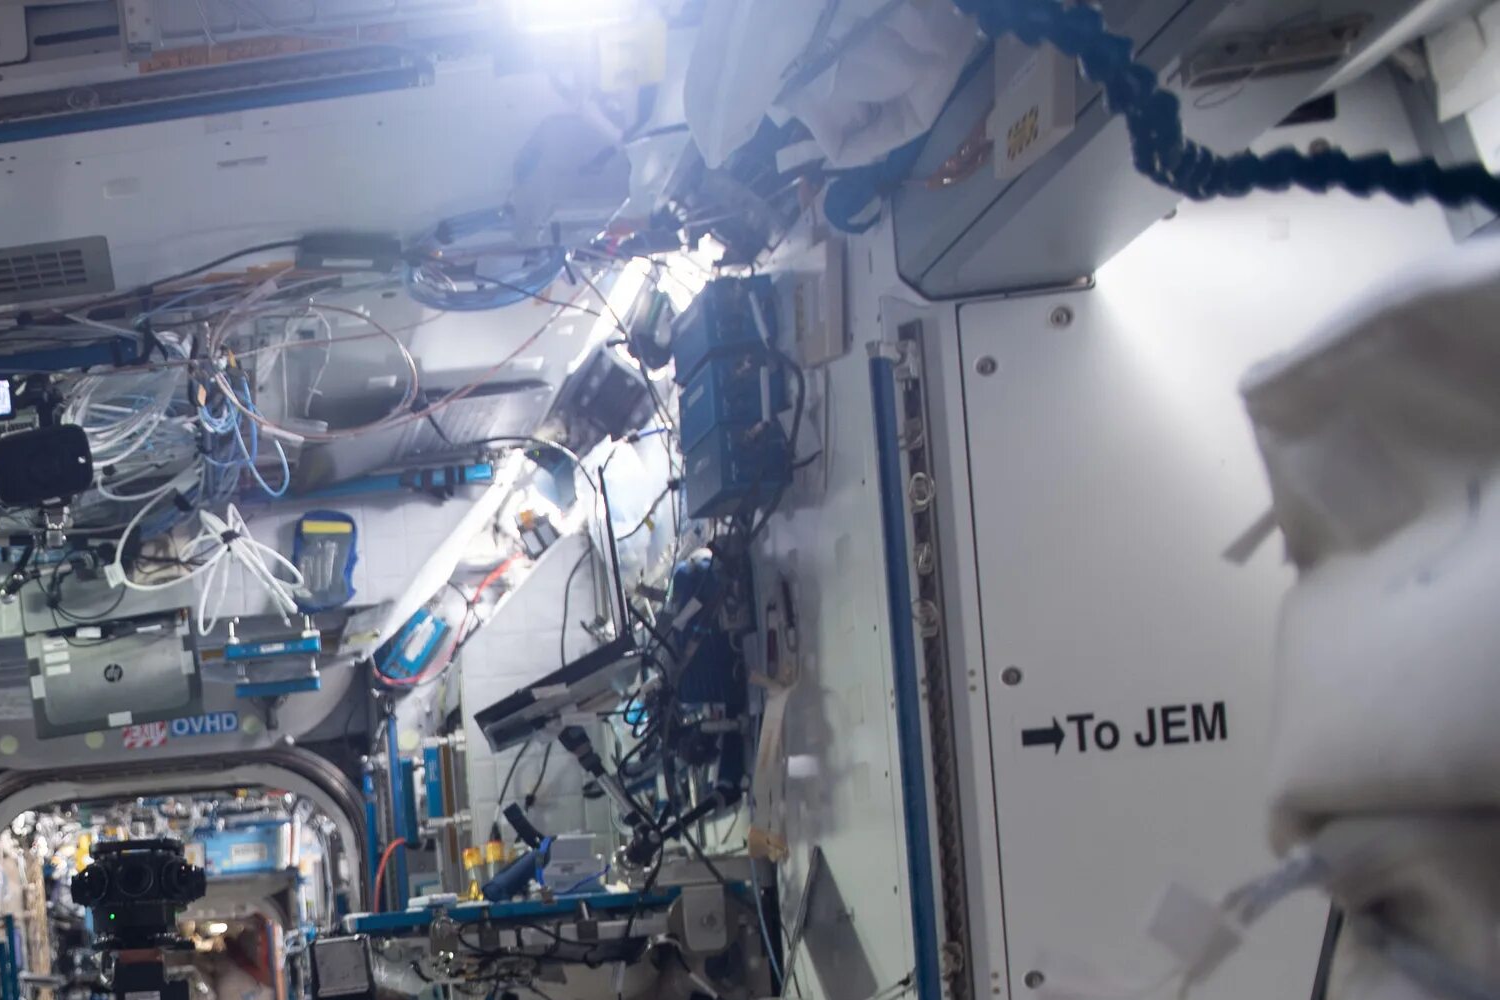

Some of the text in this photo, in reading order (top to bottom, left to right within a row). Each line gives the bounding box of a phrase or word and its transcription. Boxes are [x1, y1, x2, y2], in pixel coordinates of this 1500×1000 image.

[172, 712, 237, 735] OVHD
[1066, 701, 1227, 752] To JEM
